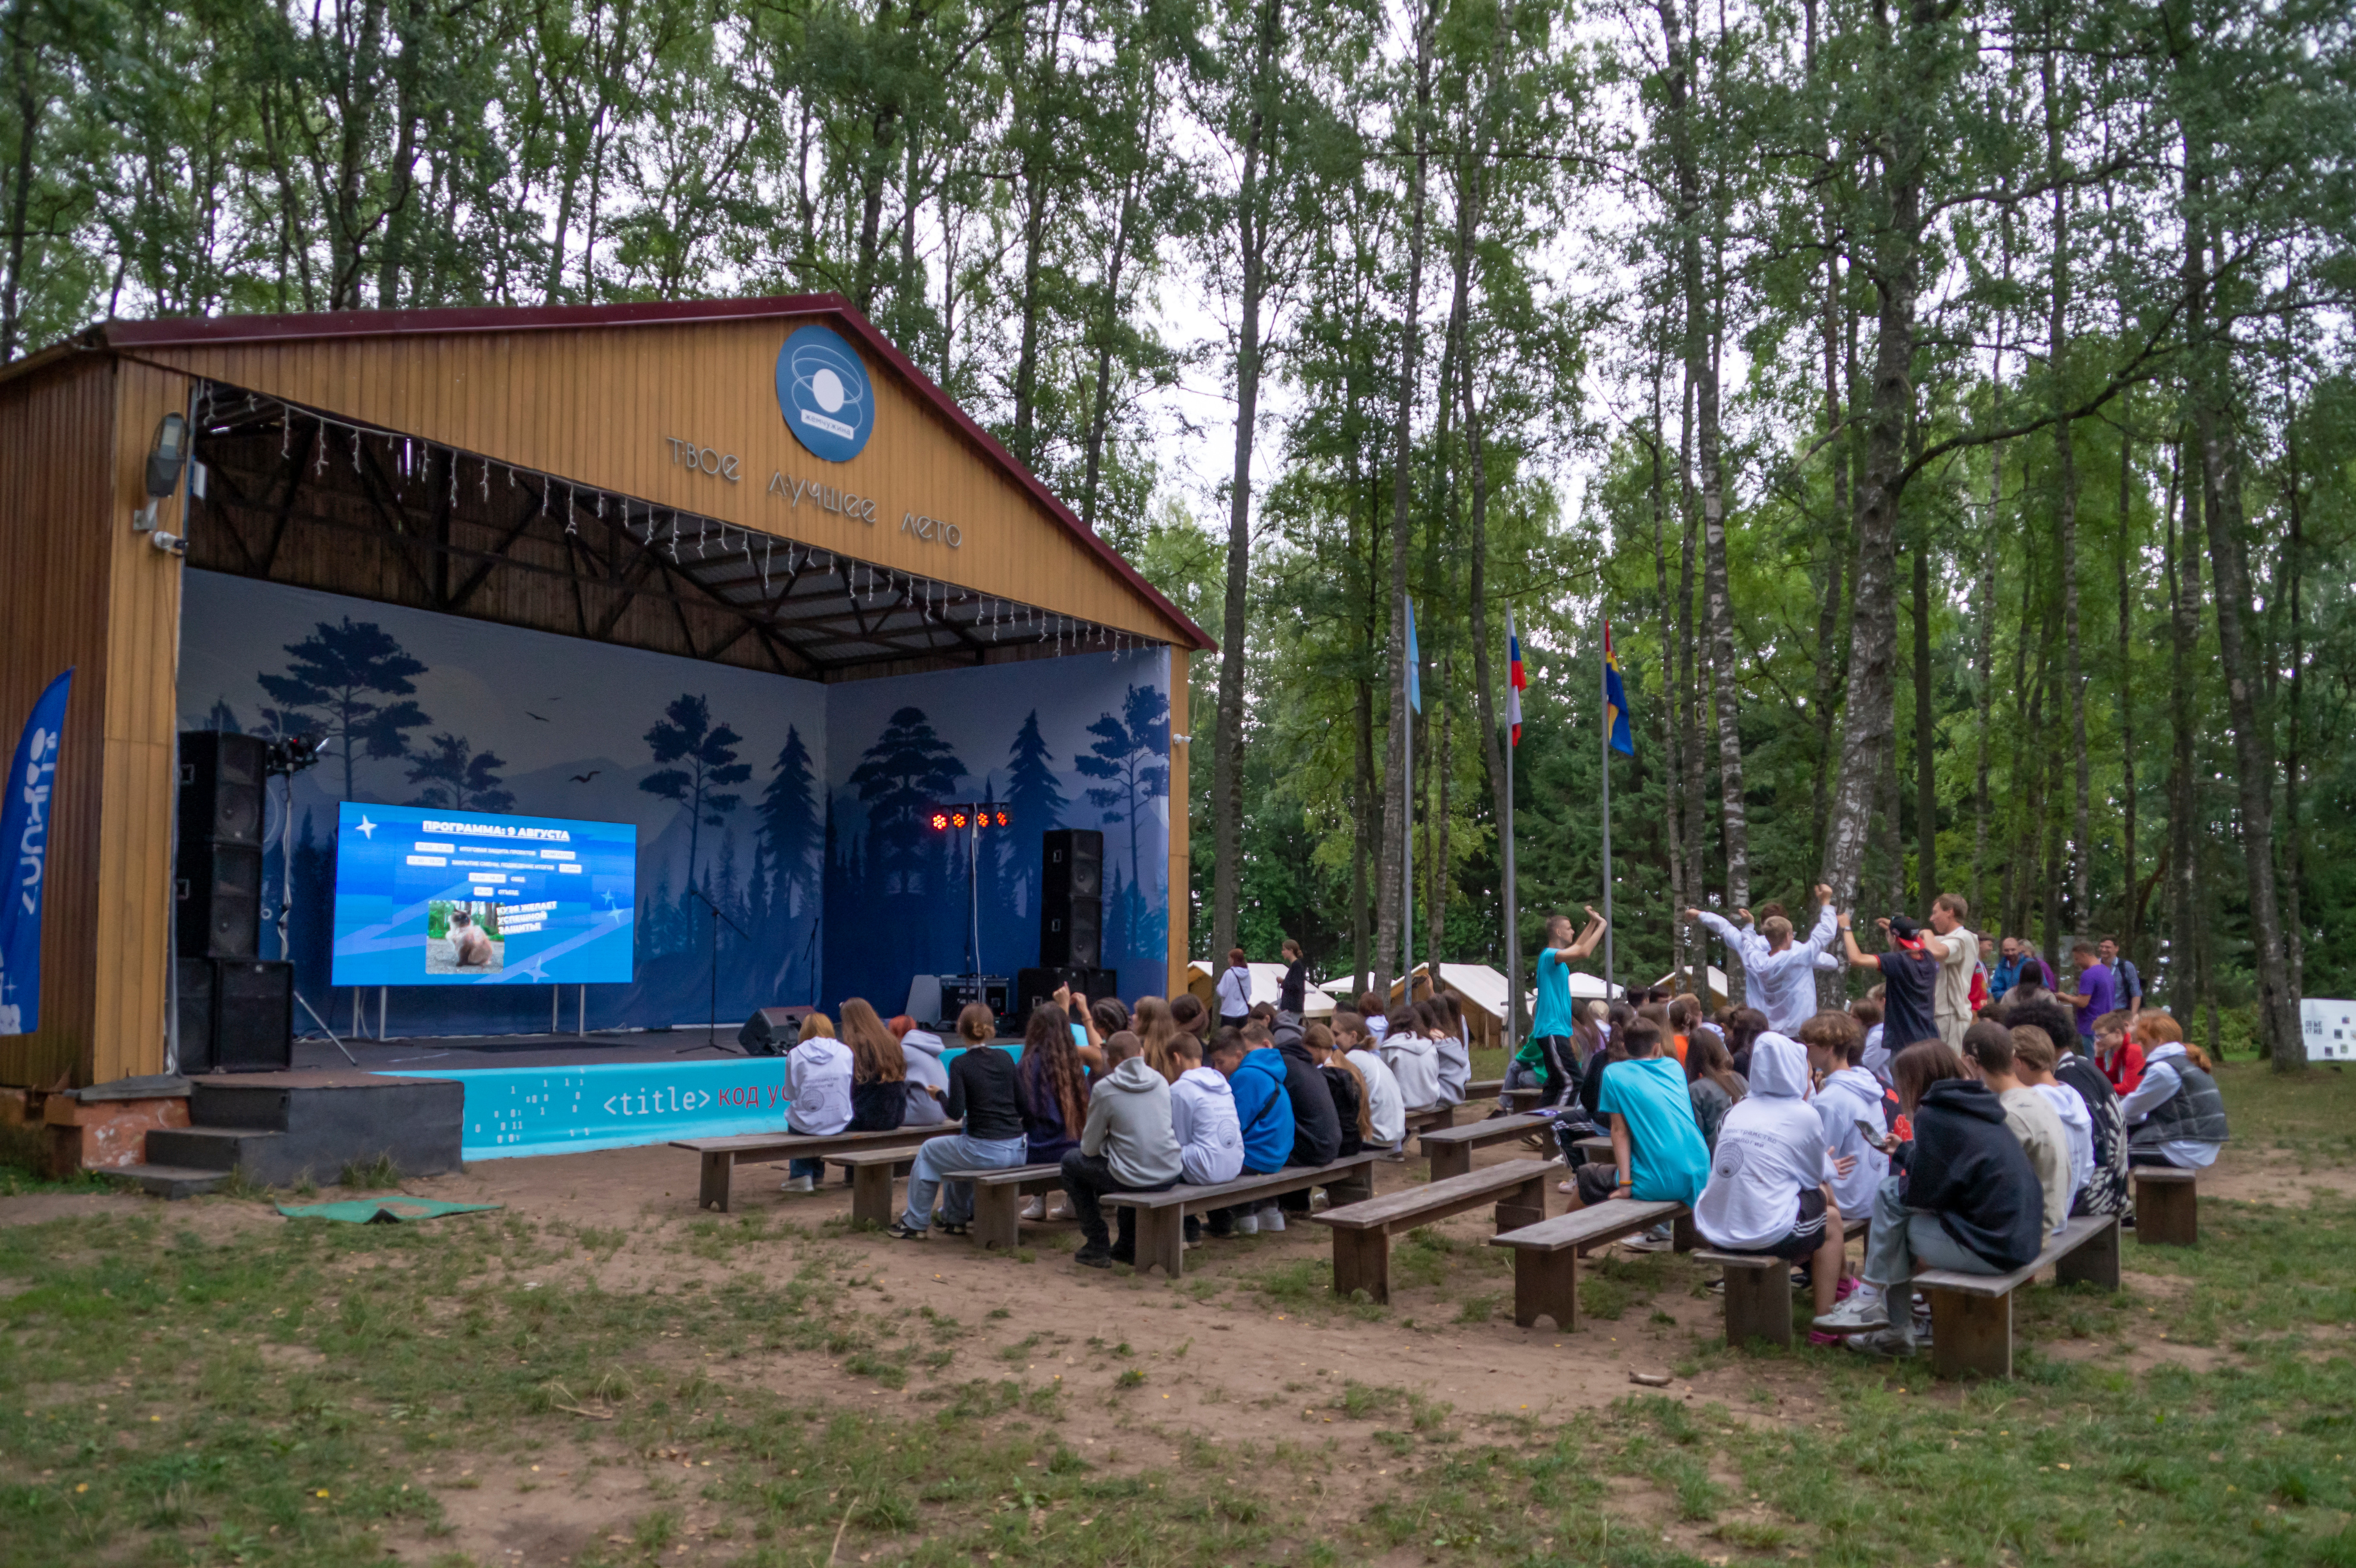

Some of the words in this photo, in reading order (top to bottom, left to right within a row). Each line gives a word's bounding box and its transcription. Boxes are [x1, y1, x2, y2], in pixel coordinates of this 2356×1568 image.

[805, 414, 851, 436] жемчужина
[423, 820, 506, 835] ПРОГРАММА:
[507, 826, 516, 836] 9
[518, 827, 570, 840] АВГУСТА
[496, 905, 519, 916] КУЗЯ
[520, 901, 557, 913] ЖЕЛАЕТ
[497, 910, 548, 926] УСПЕШНОЙ
[604, 1086, 710, 1116] <title>
